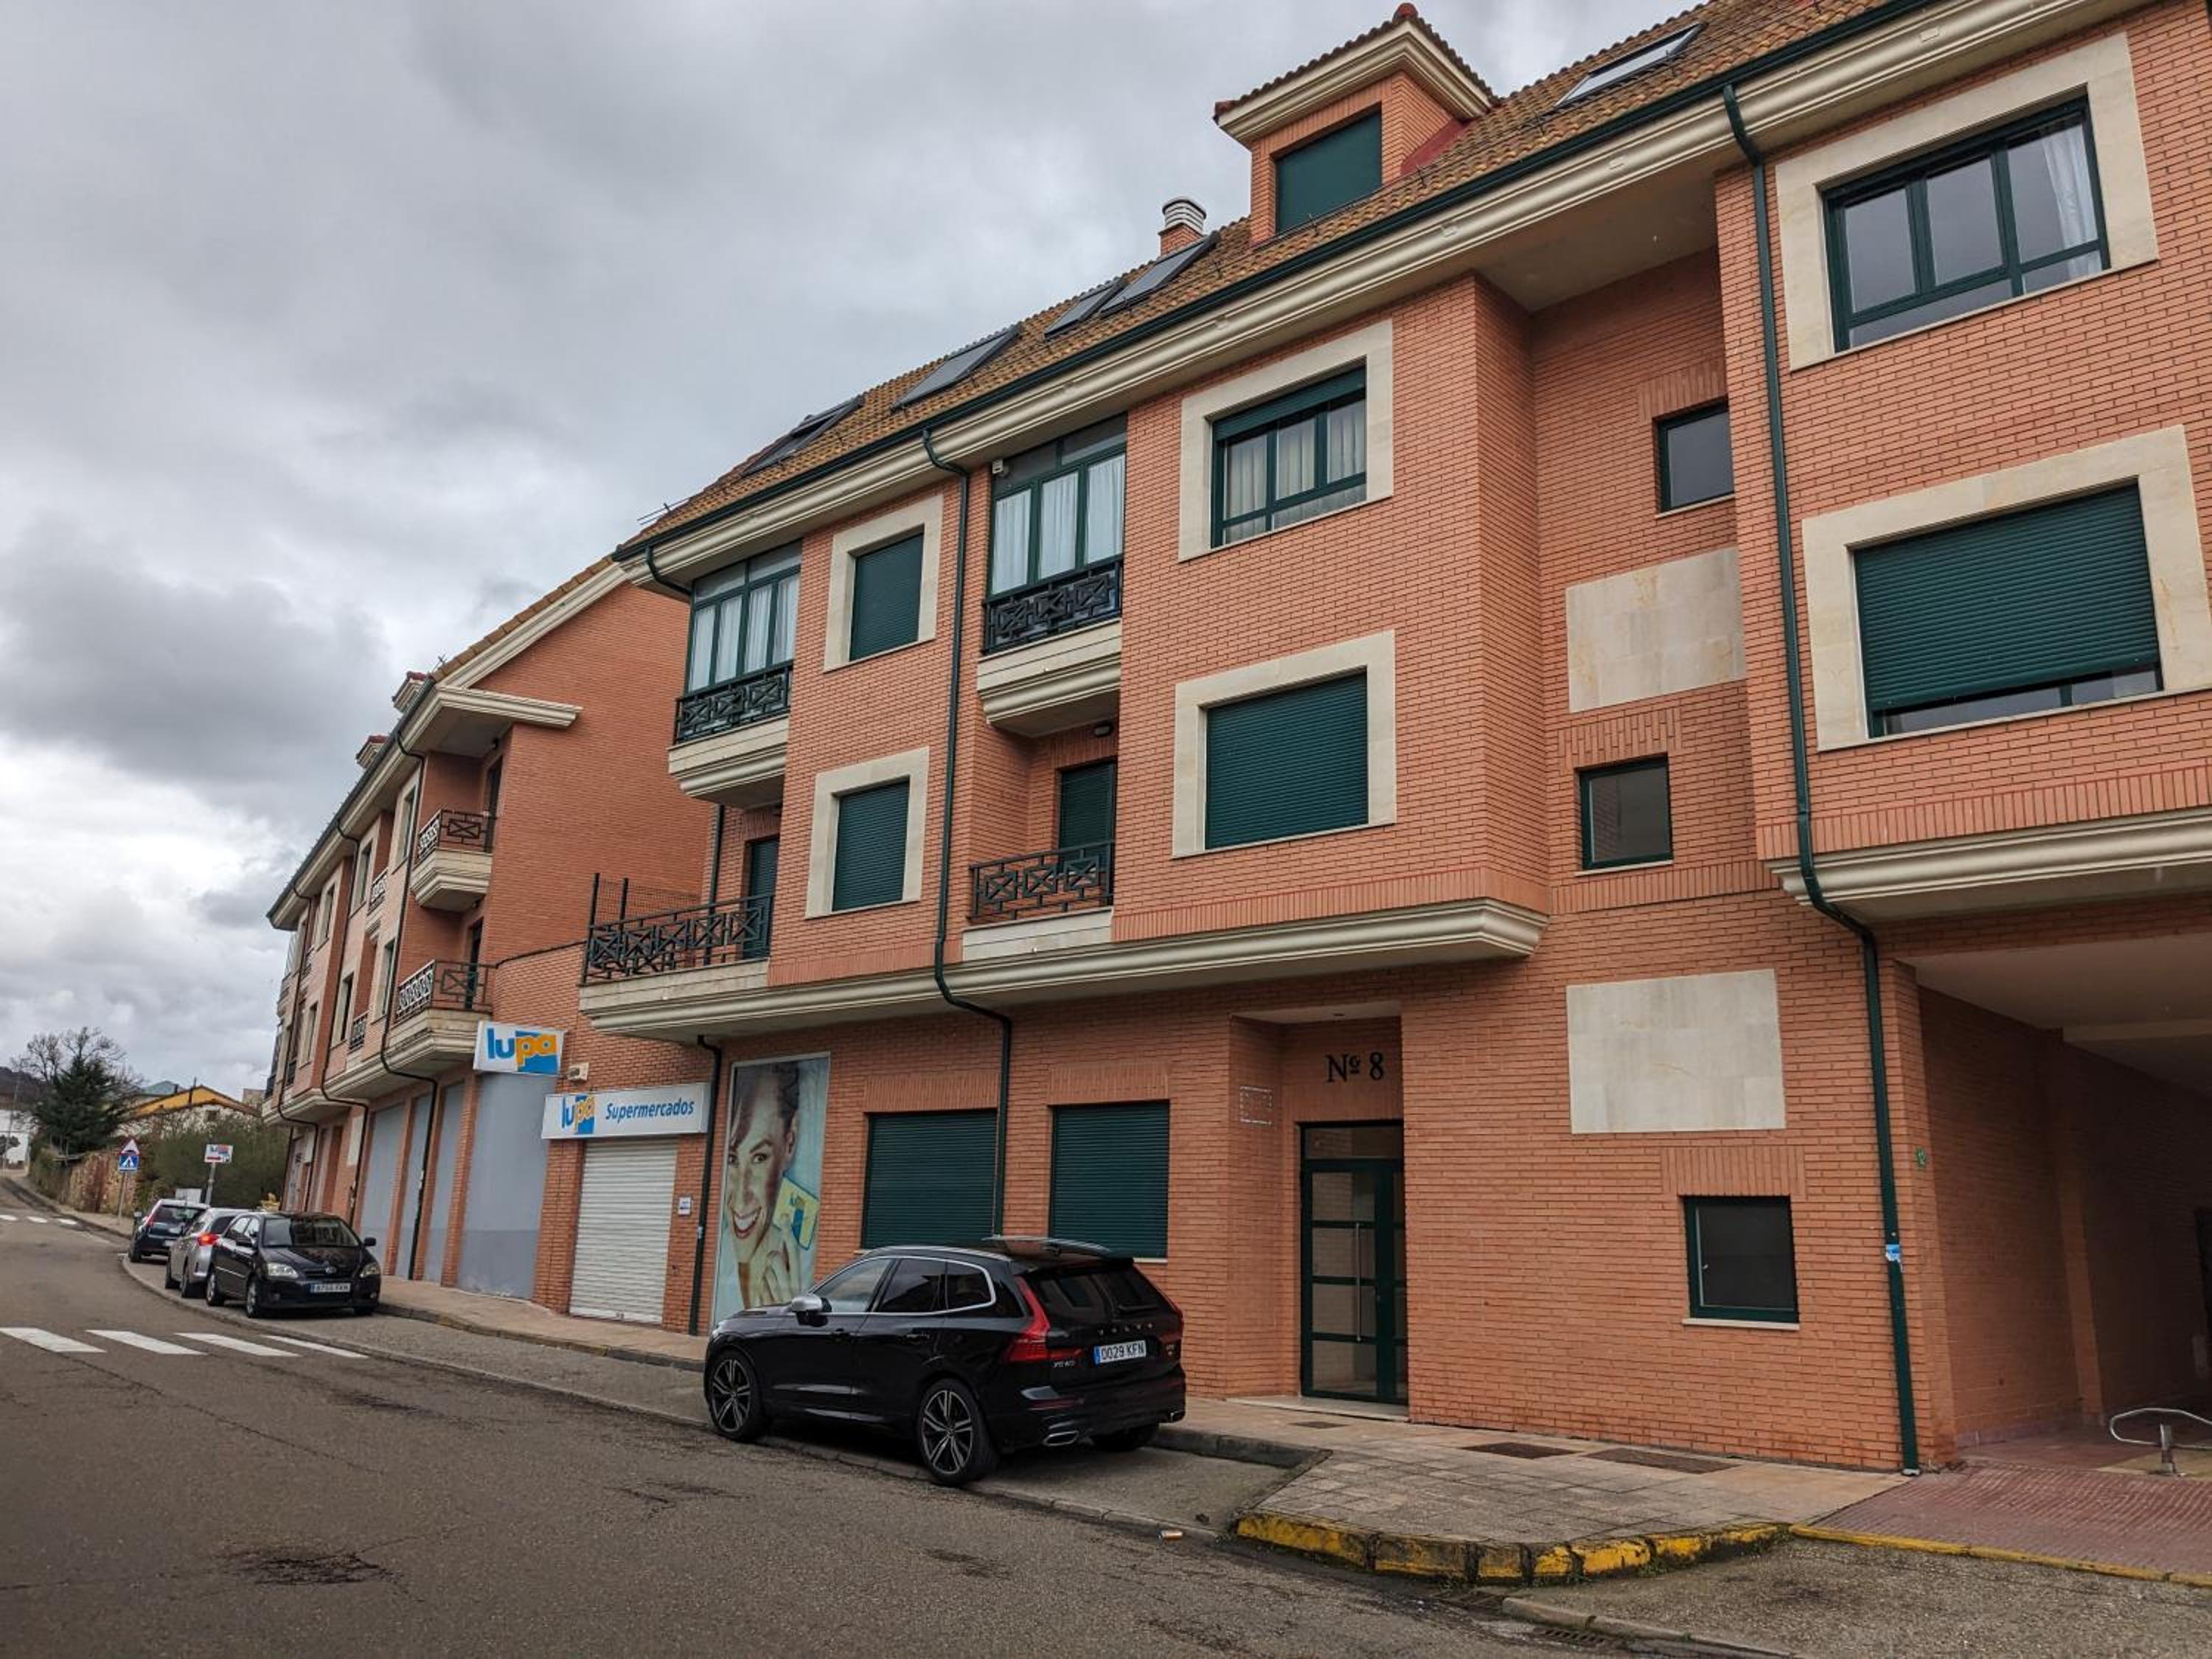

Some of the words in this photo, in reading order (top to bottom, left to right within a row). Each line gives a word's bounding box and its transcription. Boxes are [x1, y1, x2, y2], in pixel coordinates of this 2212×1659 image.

[487, 1028, 557, 1066] lupa
[1369, 1051, 1384, 1081] 8
[605, 1097, 695, 1122] Supermercados
[1102, 1345, 1124, 1360] 0029
[1126, 1343, 1144, 1357] KFN
